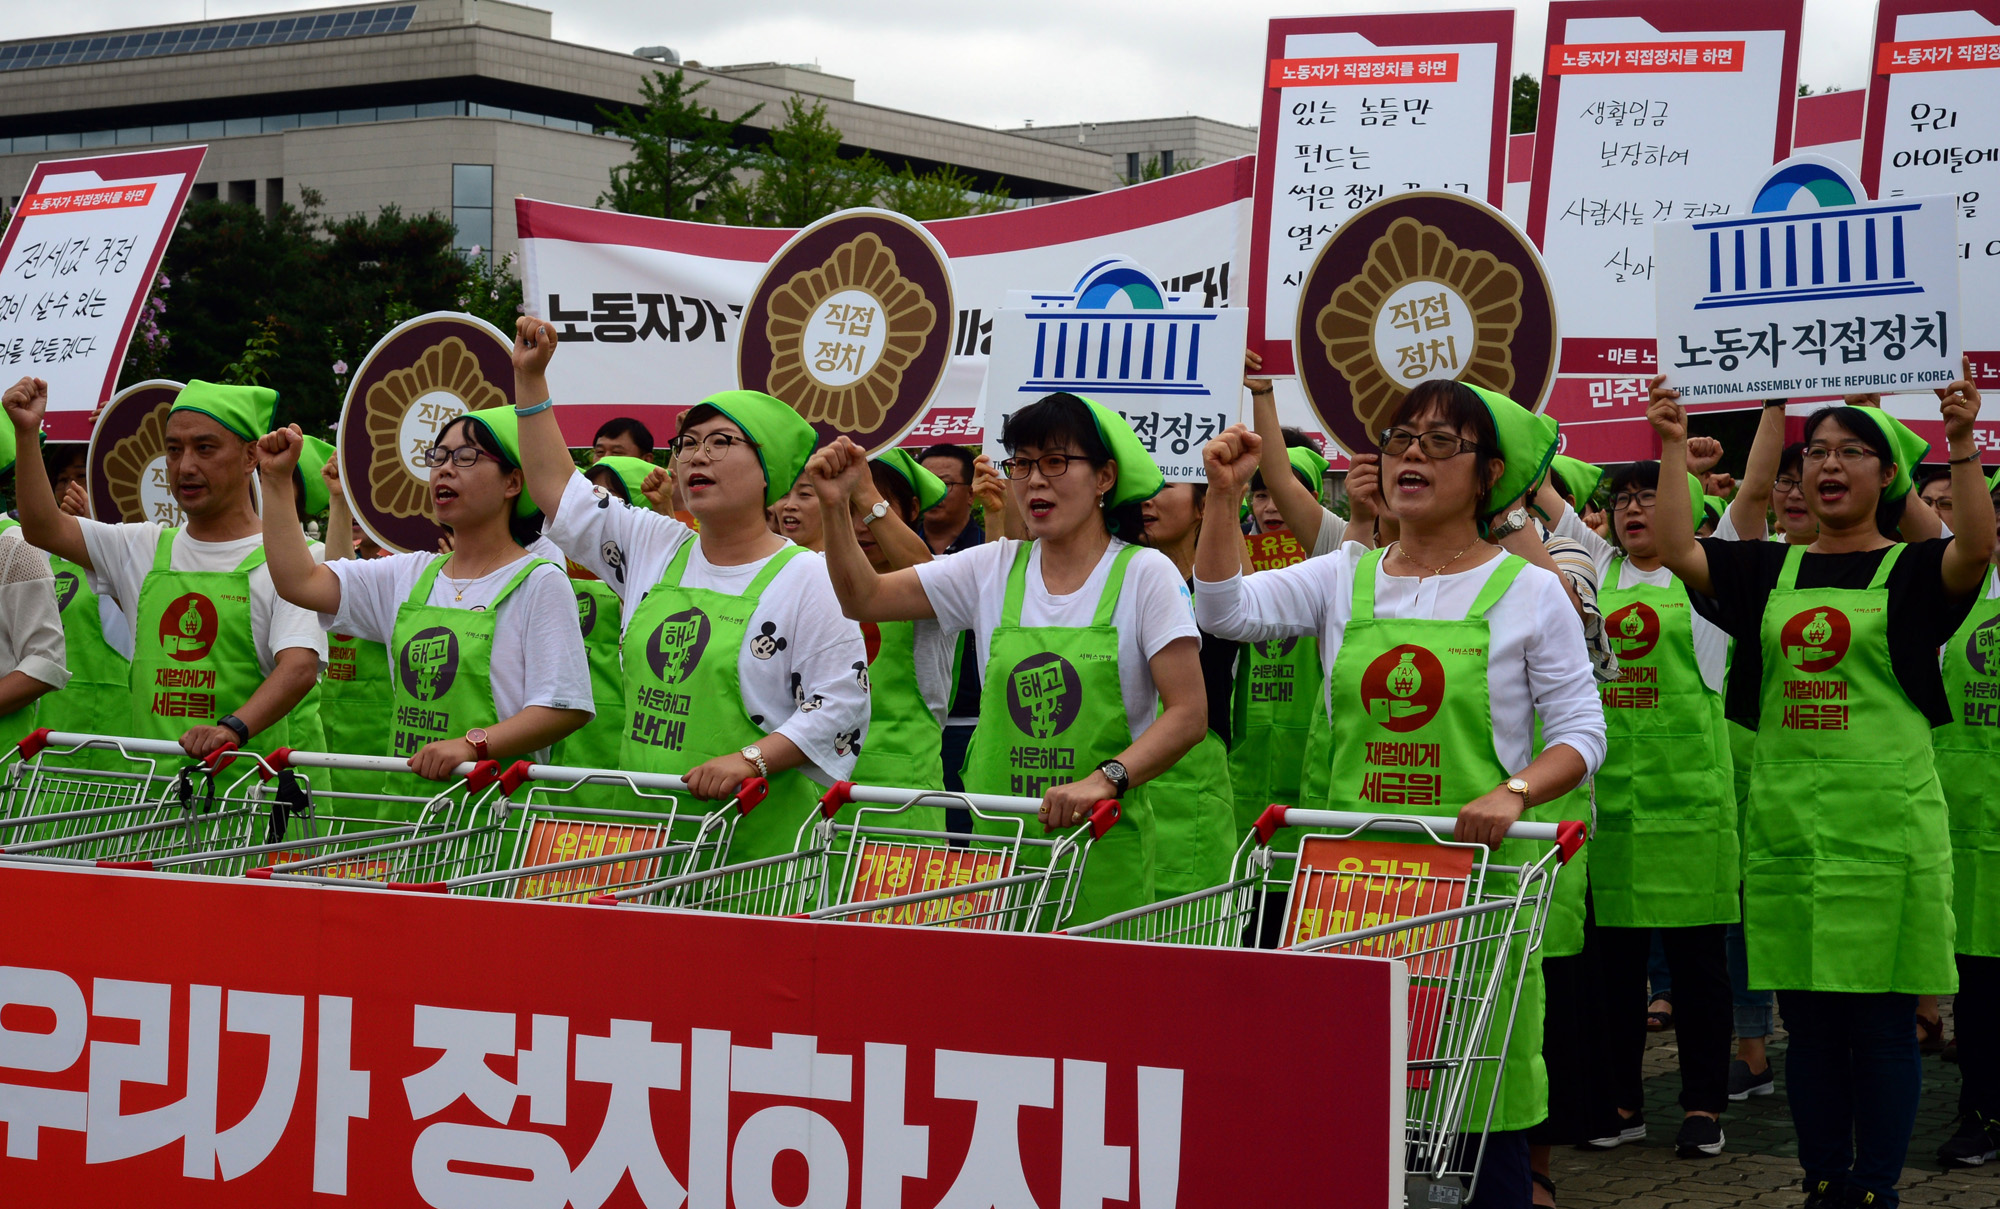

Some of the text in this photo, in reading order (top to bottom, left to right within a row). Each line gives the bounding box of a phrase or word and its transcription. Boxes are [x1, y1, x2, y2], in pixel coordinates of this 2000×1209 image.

[1562, 48, 1732, 67] 노동자가 직접정치를 하면
[1891, 46, 1953, 64] 노동자가
[1282, 60, 1447, 79] 노동자가 직접정치를 하면
[1291, 97, 1433, 126] 있는 놈들만
[1580, 100, 1668, 126] 생활임금
[1910, 103, 1957, 132] 우리
[1601, 141, 1689, 168] 보장하여
[29, 189, 146, 210] 노동자가 직접정치를 하면
[1288, 184, 1335, 211] 썩은
[14, 235, 138, 279] 전세값 걱정
[72, 288, 107, 318] 있는
[1388, 292, 1451, 334] 직접
[548, 292, 727, 343] 노동자가
[824, 302, 876, 336] 직접
[30, 336, 97, 364] 만들겠다
[814, 340, 867, 376] 정치
[1396, 335, 1458, 379] 정치
[1608, 348, 1637, 365] 마트
[1641, 349, 1657, 364] 노
[1673, 370, 1954, 397] THE NATIONAL ASSEMBLY OF THE REPUBLIC OF KOREA
[1982, 363, 2000, 378] 노
[1119, 411, 1226, 454] 접정치
[410, 439, 436, 468] 정
[152, 468, 171, 496] 직
[993, 461, 1003, 470] TH
[1181, 467, 1193, 476] OF
[1261, 534, 1305, 557] 유능
[187, 611, 197, 619] TAX
[665, 620, 697, 648] 해고
[412, 640, 446, 664] 해고
[1448, 647, 1482, 657] 서비스연맹
[155, 668, 216, 689] 재벌에게
[1020, 667, 1063, 698] 해고
[1252, 664, 1294, 679] 쉬운해고
[1396, 667, 1414, 676] TAX
[637, 684, 691, 716] 쉬운해고
[1251, 682, 1293, 702] 반대!
[1602, 687, 1659, 709] 세금을!
[1783, 680, 1847, 700] 재벌에게
[151, 692, 215, 719] 세금을!
[397, 705, 449, 733] 쉬운해고
[1782, 705, 1848, 730] 세금을!
[631, 711, 686, 752] 반대!
[1010, 746, 1075, 769] 쉬운해고
[1365, 742, 1440, 768] 재벌에게
[1359, 772, 1441, 806] 세금을!
[859, 854, 913, 888] 가장
[0, 965, 1185, 1209] 우리가 정치하자!
